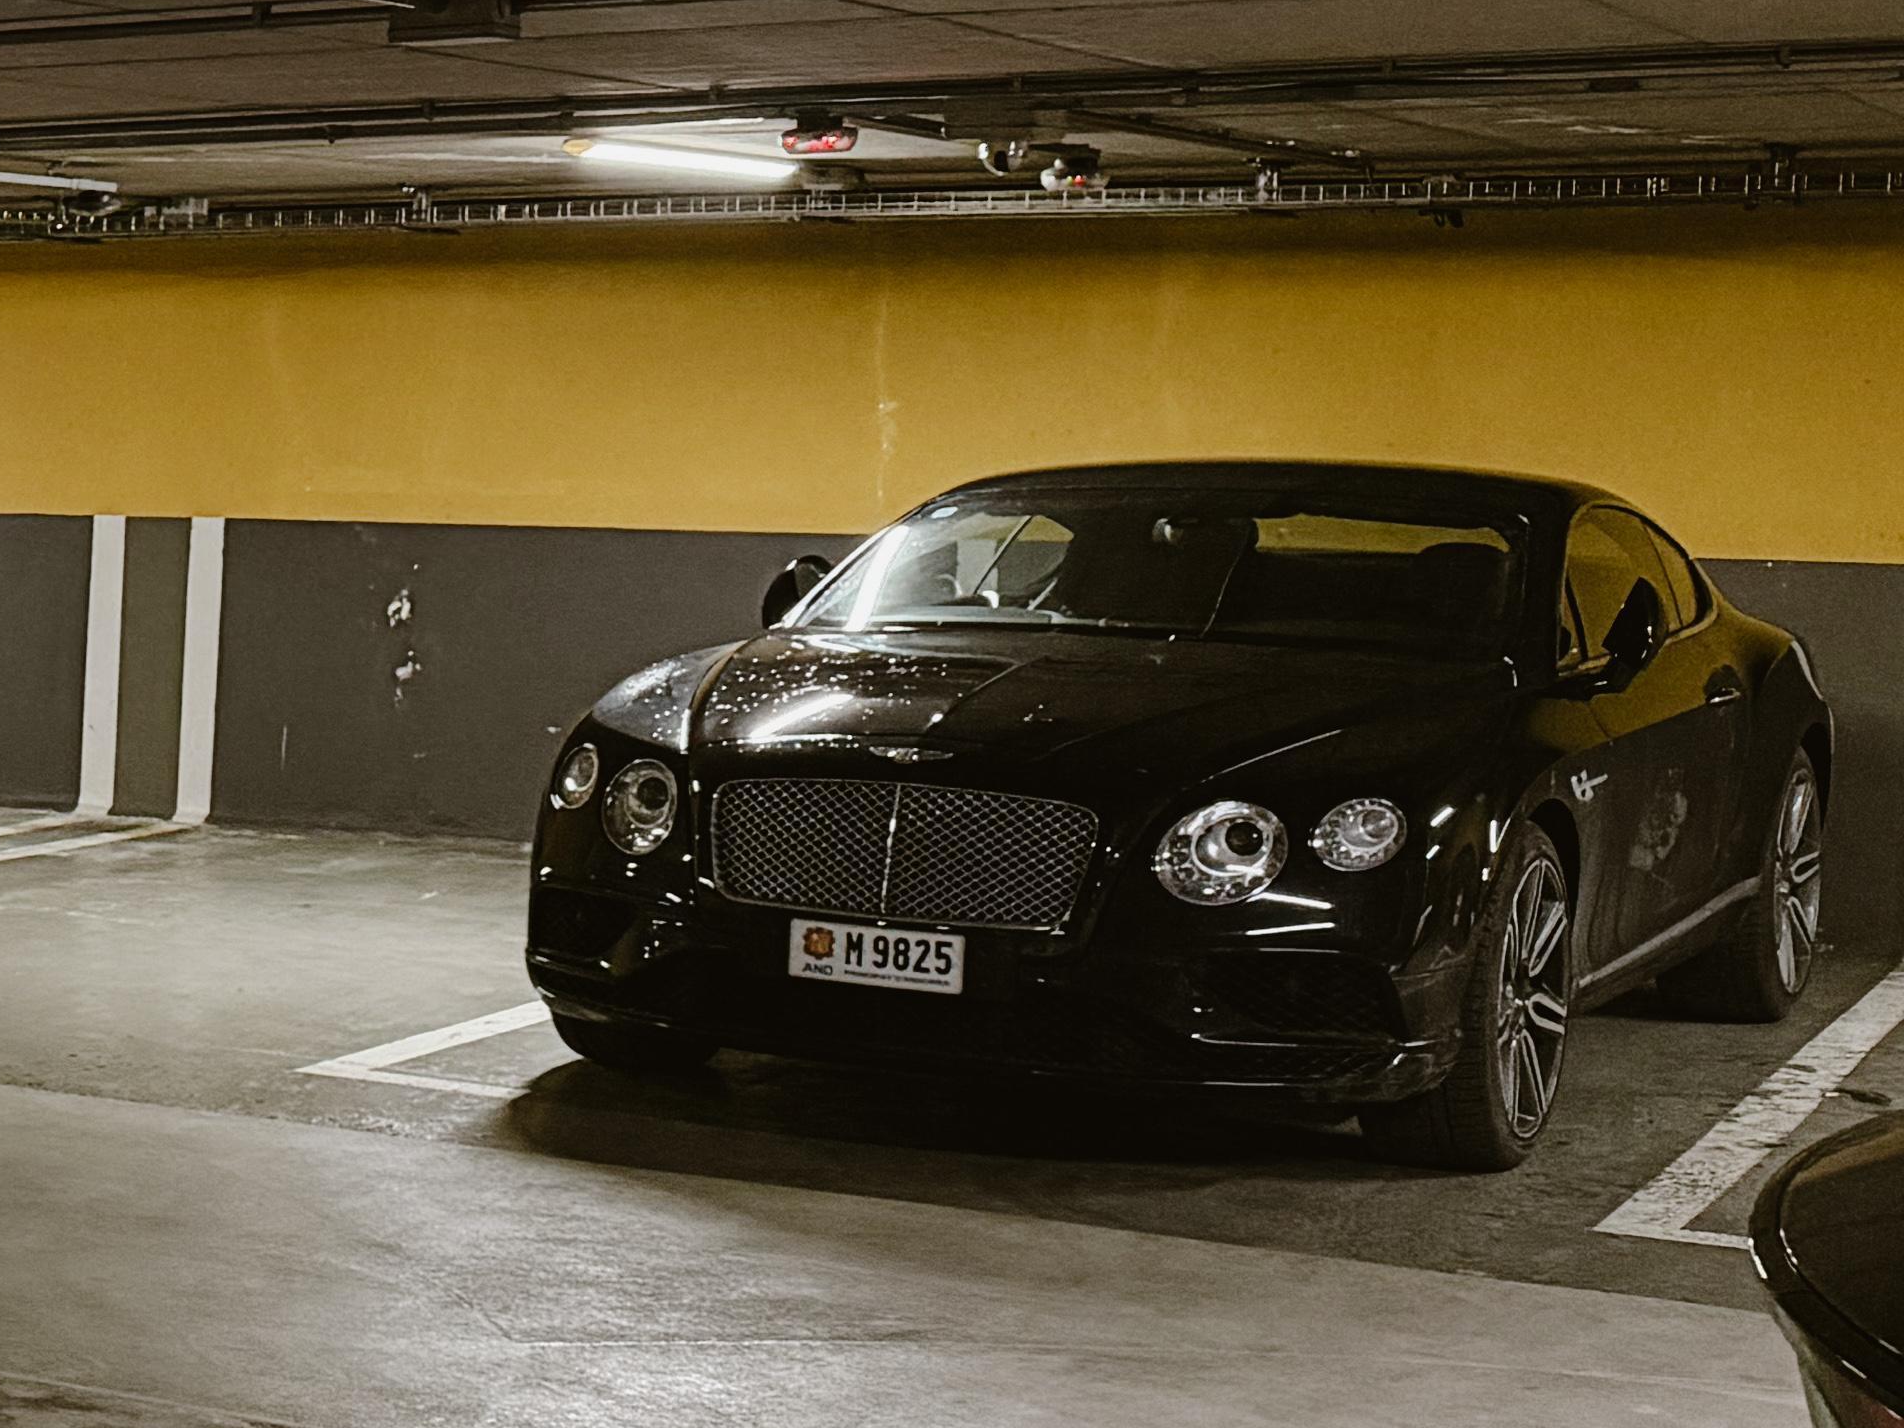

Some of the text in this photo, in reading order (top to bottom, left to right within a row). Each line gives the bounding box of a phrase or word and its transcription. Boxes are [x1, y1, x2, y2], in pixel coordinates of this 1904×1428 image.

[844, 931, 954, 976] M 9825
[802, 962, 833, 977] AND
